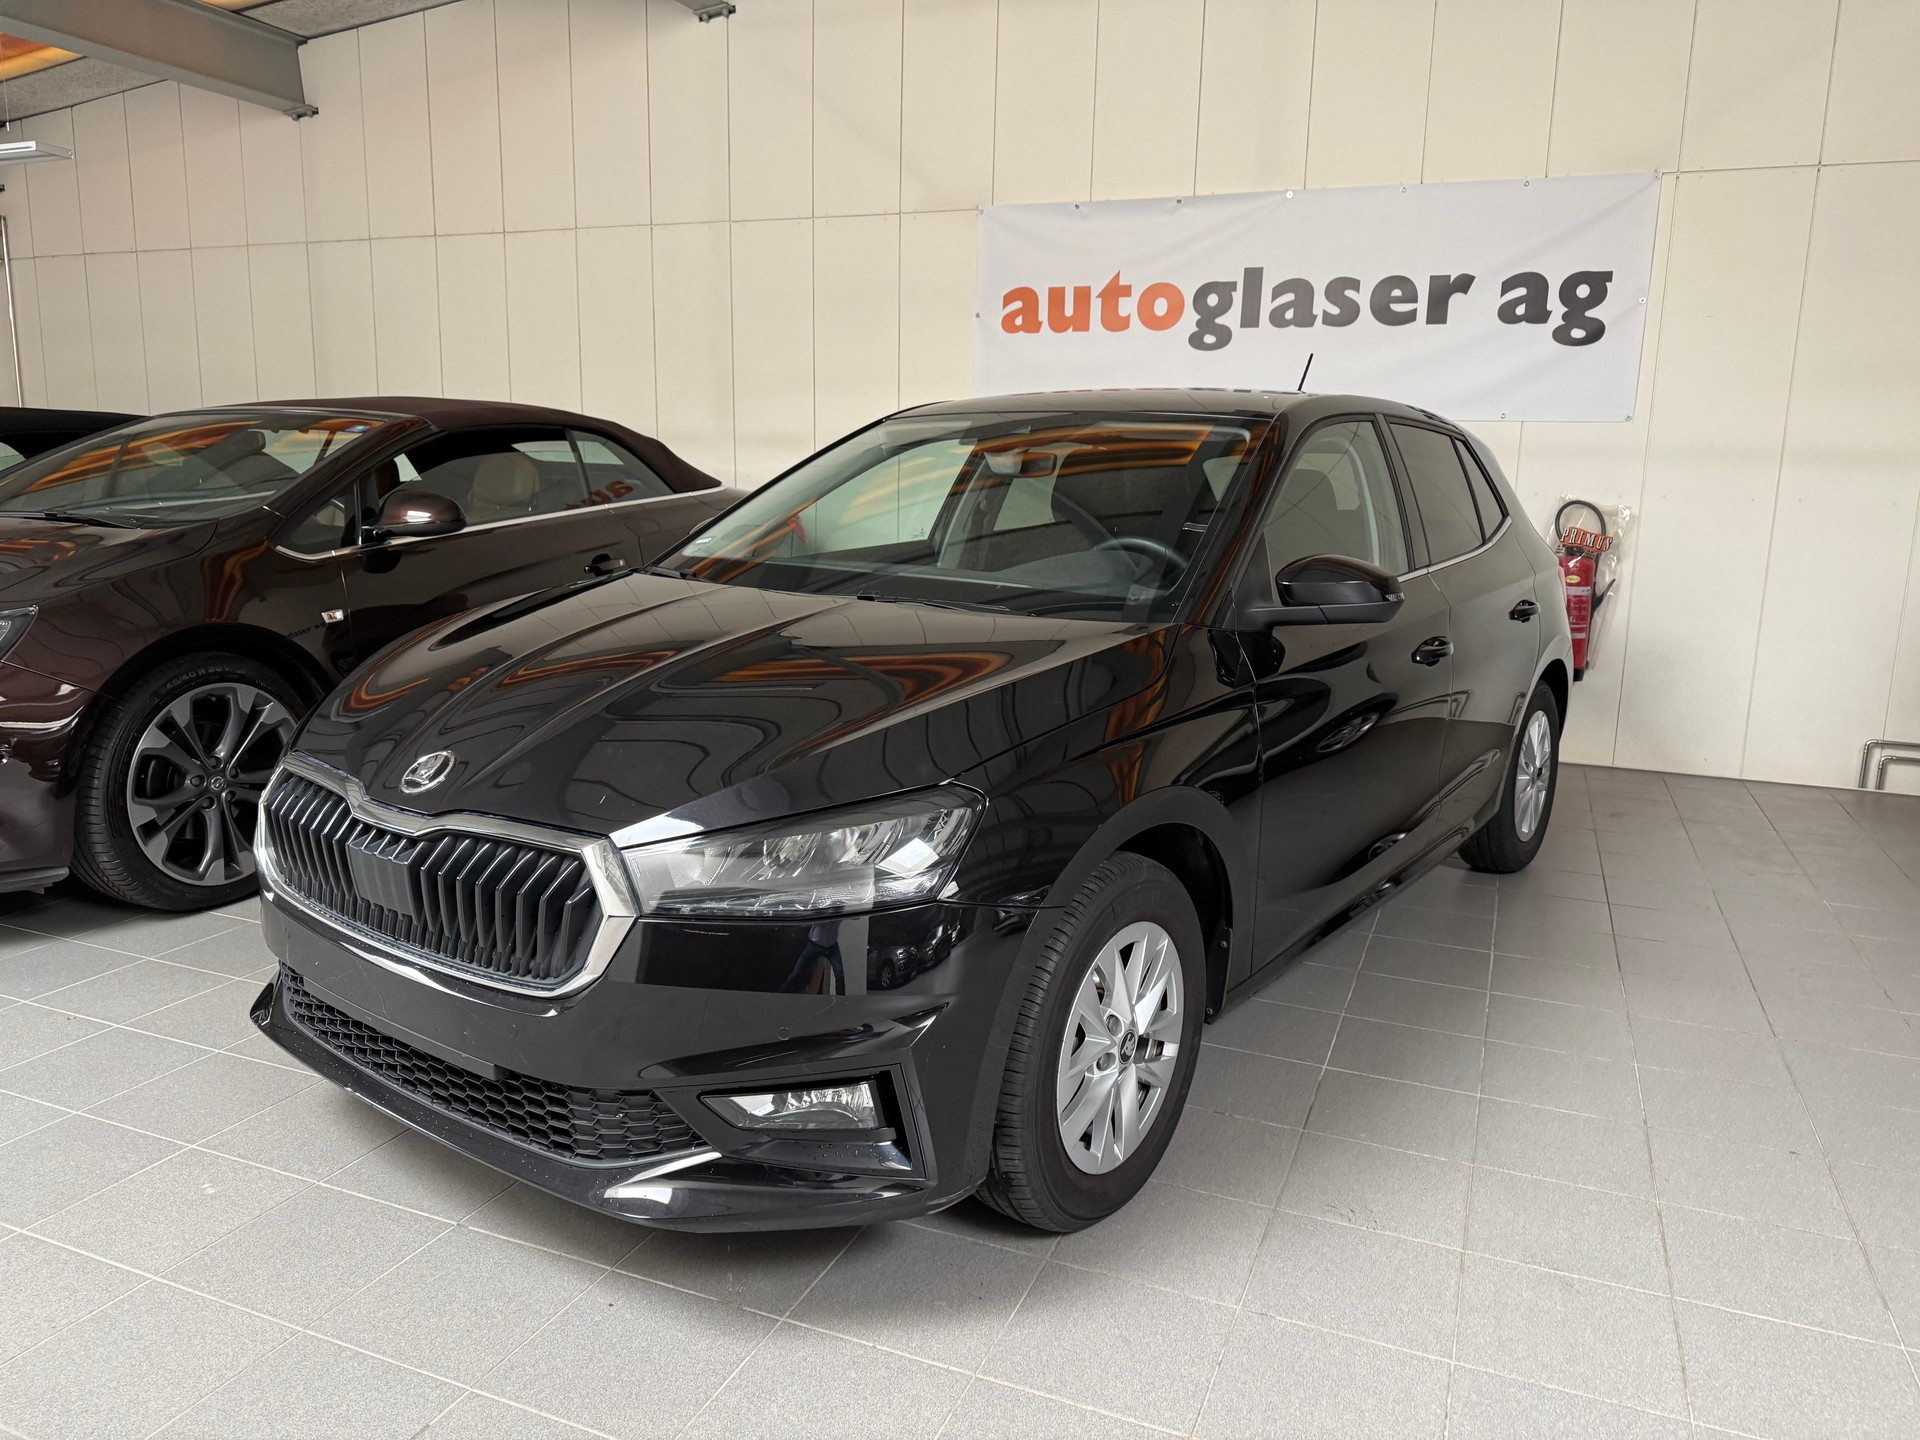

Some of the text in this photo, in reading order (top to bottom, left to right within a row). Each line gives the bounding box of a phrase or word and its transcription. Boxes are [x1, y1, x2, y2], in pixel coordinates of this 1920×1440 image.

[1000, 266, 1614, 351] autoglaser ag
[1560, 527, 1613, 552] PRIMUS
